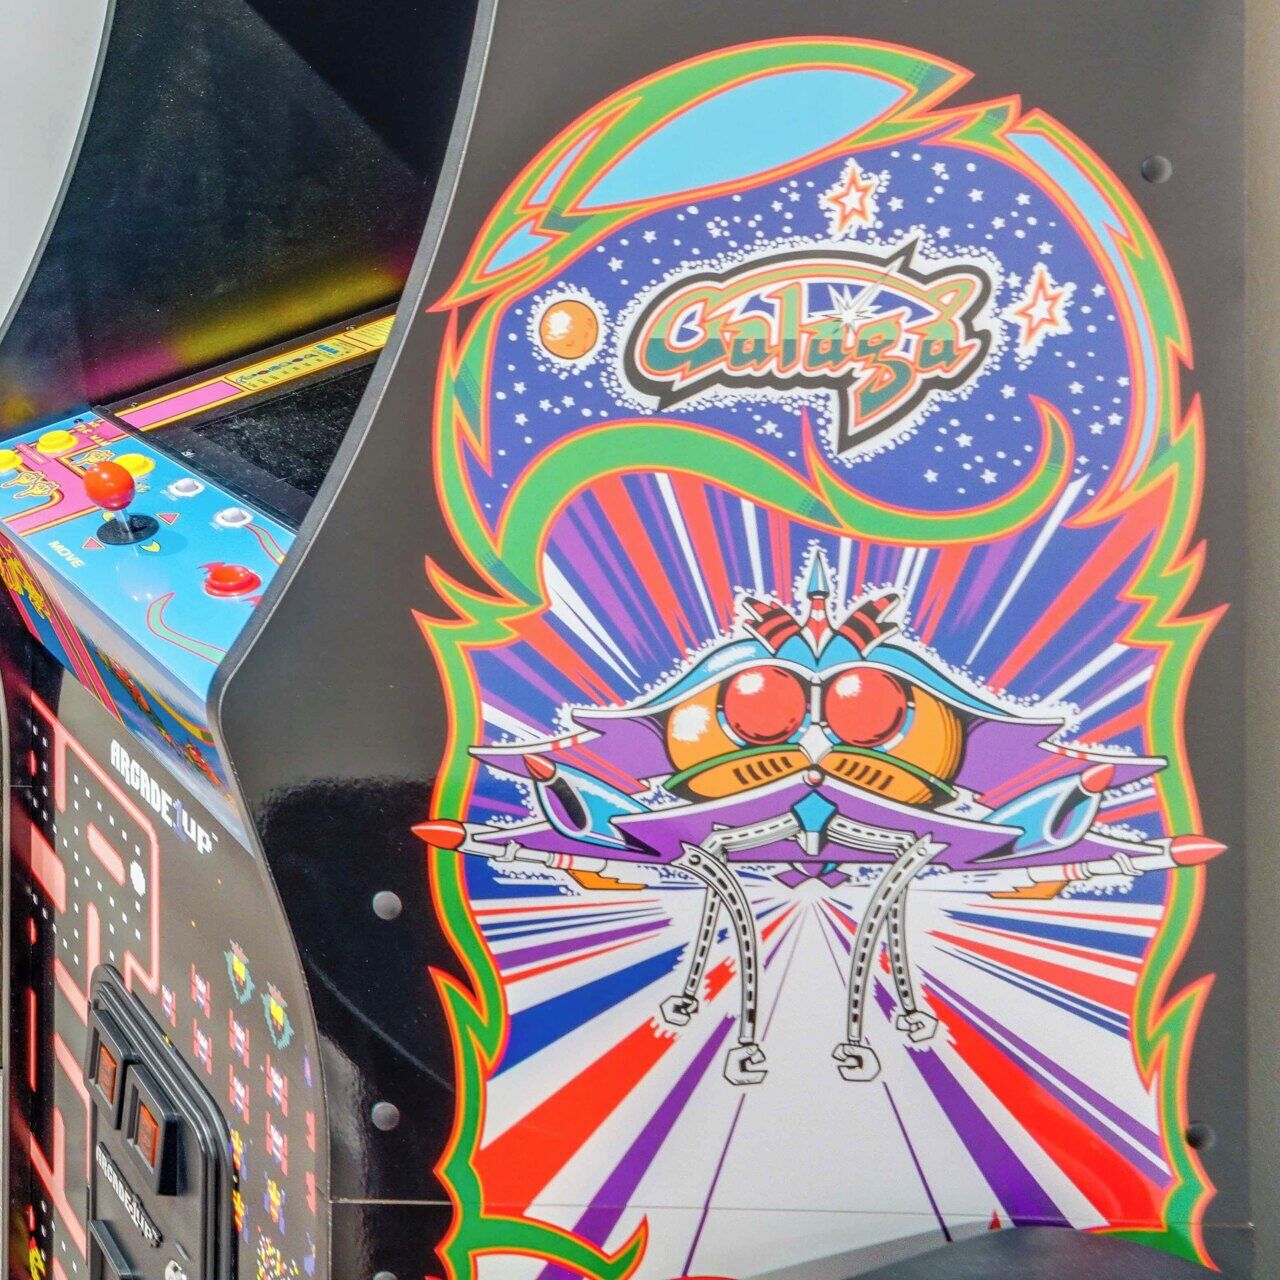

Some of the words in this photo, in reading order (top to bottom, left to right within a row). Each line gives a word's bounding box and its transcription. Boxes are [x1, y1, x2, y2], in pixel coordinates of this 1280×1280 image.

[639, 263, 977, 429] Galaga
[48, 541, 86, 568] MOVE
[111, 739, 212, 854] ARCADE1UP
[96, 1144, 160, 1242] ARCADE1UP
